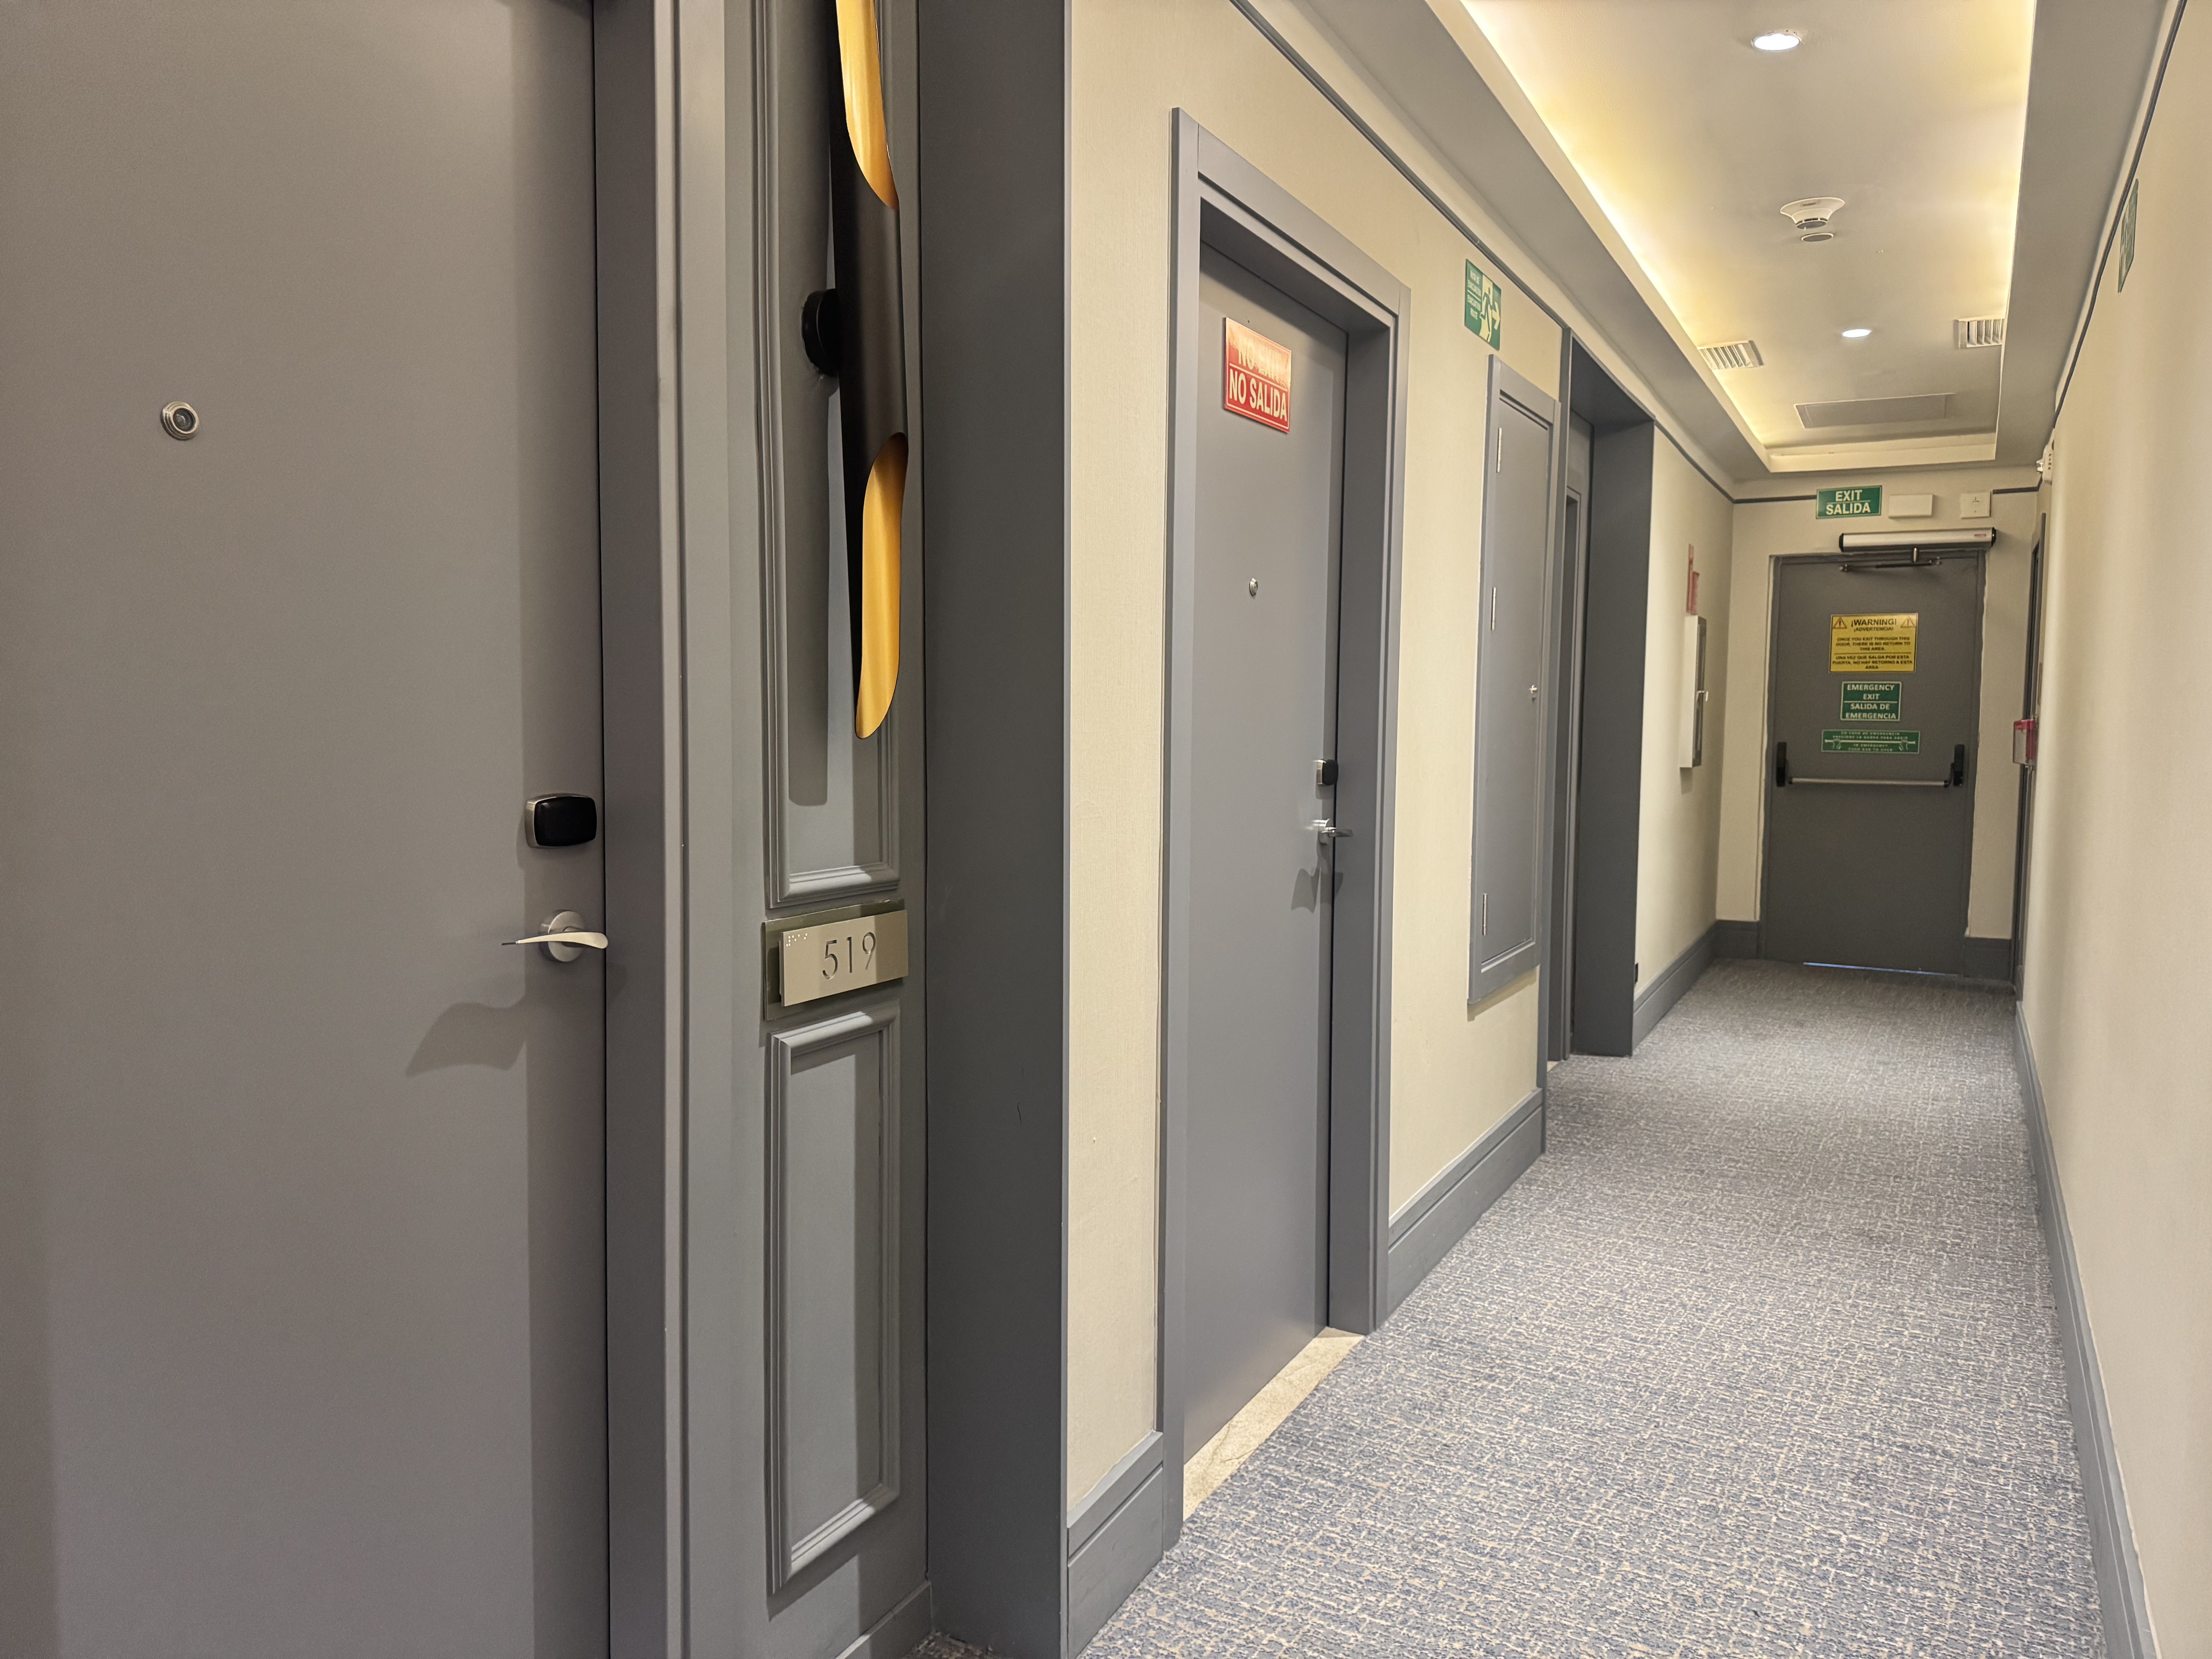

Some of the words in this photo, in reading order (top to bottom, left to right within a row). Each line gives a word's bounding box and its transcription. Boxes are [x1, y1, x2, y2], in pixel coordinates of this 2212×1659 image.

[1230, 369, 1247, 404] NO
[1250, 378, 1287, 421] SALIDA
[1826, 502, 1871, 515] SALIDA
[1836, 489, 1863, 501] EXIT
[822, 932, 876, 979] 519
